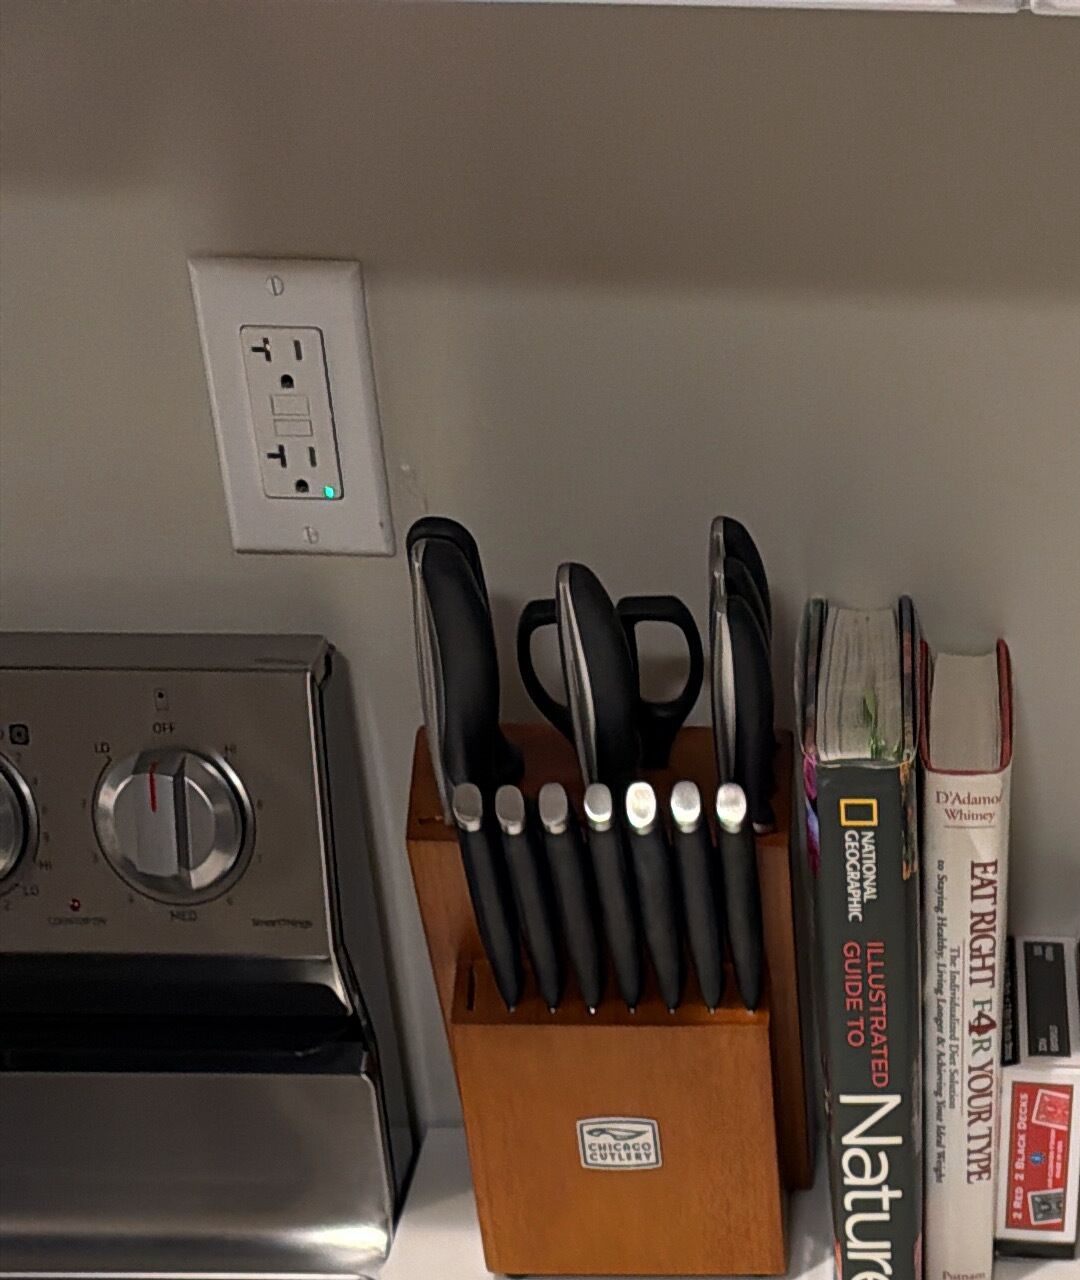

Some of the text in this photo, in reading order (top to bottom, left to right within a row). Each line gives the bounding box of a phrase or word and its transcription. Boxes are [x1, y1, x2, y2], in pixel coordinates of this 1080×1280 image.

[153, 722, 176, 734] OFF
[944, 808, 995, 822] Whitney
[844, 829, 863, 923] GEOGRAPHIC
[861, 831, 877, 904] NATIONAL
[937, 860, 945, 871] to
[934, 874, 947, 913] Staying
[970, 860, 998, 905] EAT
[969, 910, 997, 988] RIGHT
[843, 941, 865, 1047] GUIDE TO
[934, 964, 947, 995] Living
[866, 941, 890, 1088] ILLUSTRATED
[934, 999, 946, 1033] Longer
[948, 946, 960, 1109] The Individualized Diet Solution
[936, 1036, 946, 1045] &
[934, 1051, 946, 1097] Achieving
[967, 1058, 994, 1126] YOUR
[936, 1100, 946, 1122] Your
[588, 1142, 652, 1152] CHICAGO
[936, 1125, 946, 1148] Ideal
[589, 1152, 652, 1161] CUTLERY
[933, 1151, 945, 1183] Weight
[966, 1127, 992, 1184] TYPE
[1014, 1173, 1024, 1181] 2
[1013, 1211, 1022, 1220] 2
[942, 1271, 986, 1280] Putnam
